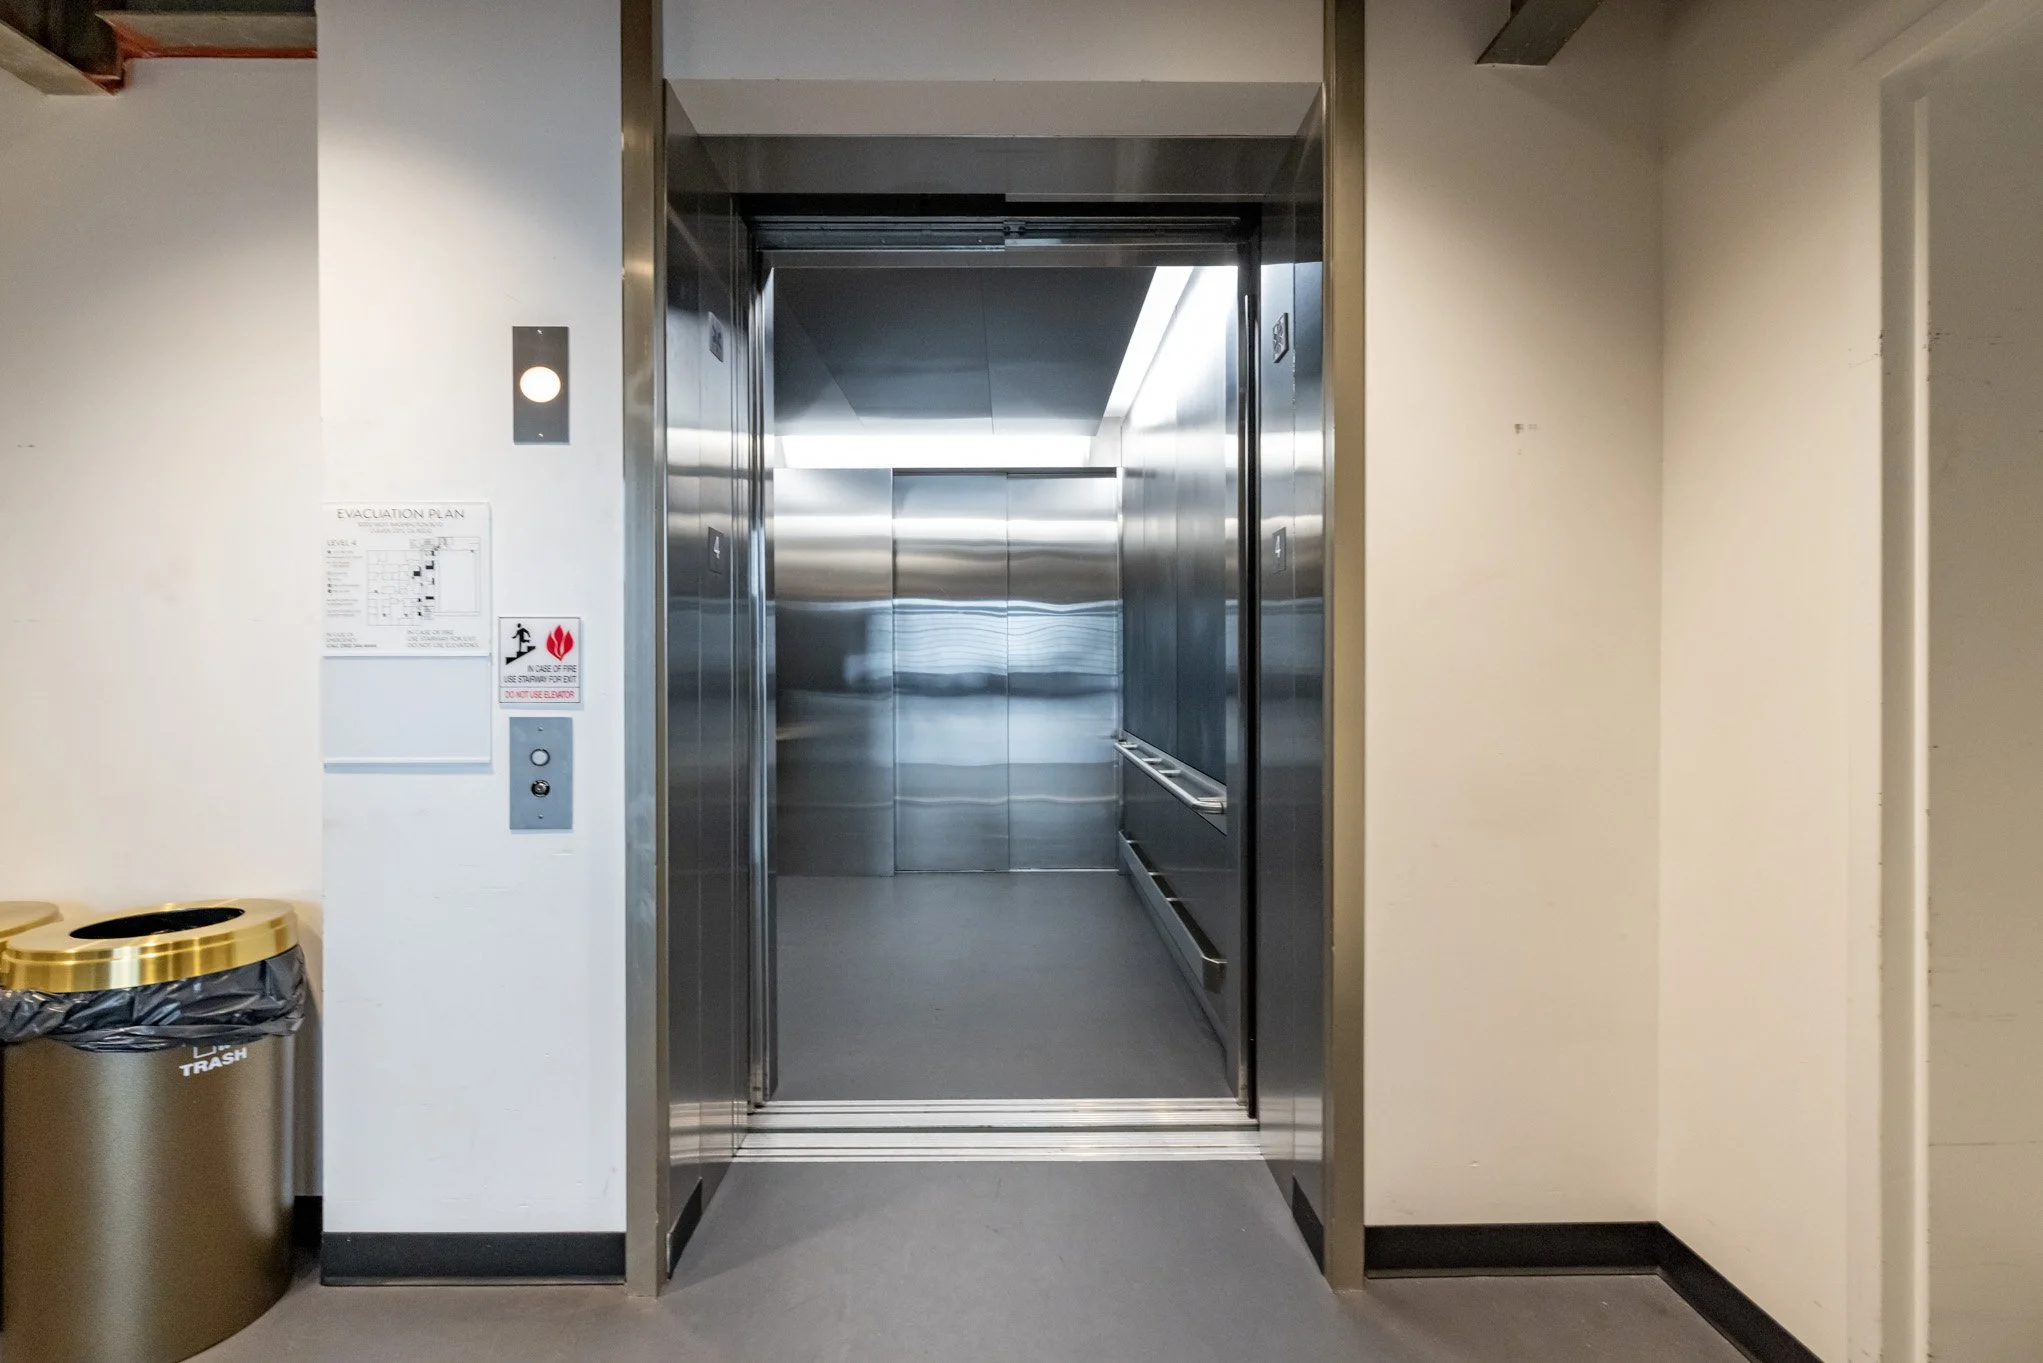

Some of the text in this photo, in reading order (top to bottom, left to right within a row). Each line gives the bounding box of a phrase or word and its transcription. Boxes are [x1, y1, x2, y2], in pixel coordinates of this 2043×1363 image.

[337, 508, 465, 519] EVACUATION PLAN
[326, 539, 350, 547] LEVEL
[713, 535, 720, 560] 4
[1274, 535, 1281, 558] 4
[527, 664, 577, 673] IN CASE OF FIRE
[504, 675, 577, 683] USE STAIRWAY FOR EXIT
[504, 690, 576, 699] DO NOT USE ELEVATOR
[179, 1046, 247, 1077] TRASH
